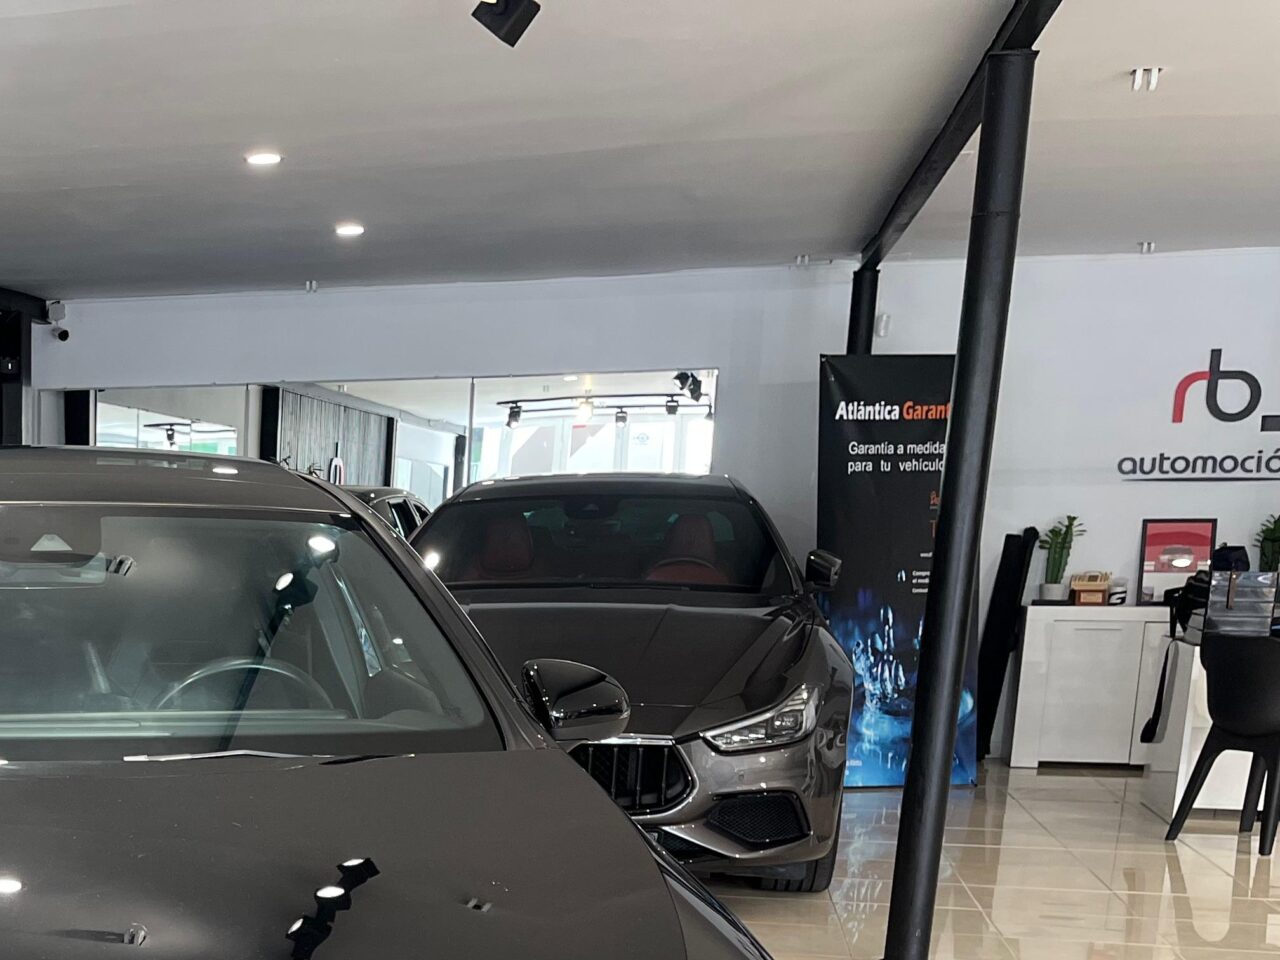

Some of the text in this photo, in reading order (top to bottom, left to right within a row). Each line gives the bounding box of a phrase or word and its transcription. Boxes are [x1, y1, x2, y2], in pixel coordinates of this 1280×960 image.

[1172, 348, 1262, 423] rb
[835, 401, 900, 420] Atlántica
[848, 441, 945, 455] Garantía a medida
[847, 461, 873, 475] para
[880, 459, 891, 471] tu
